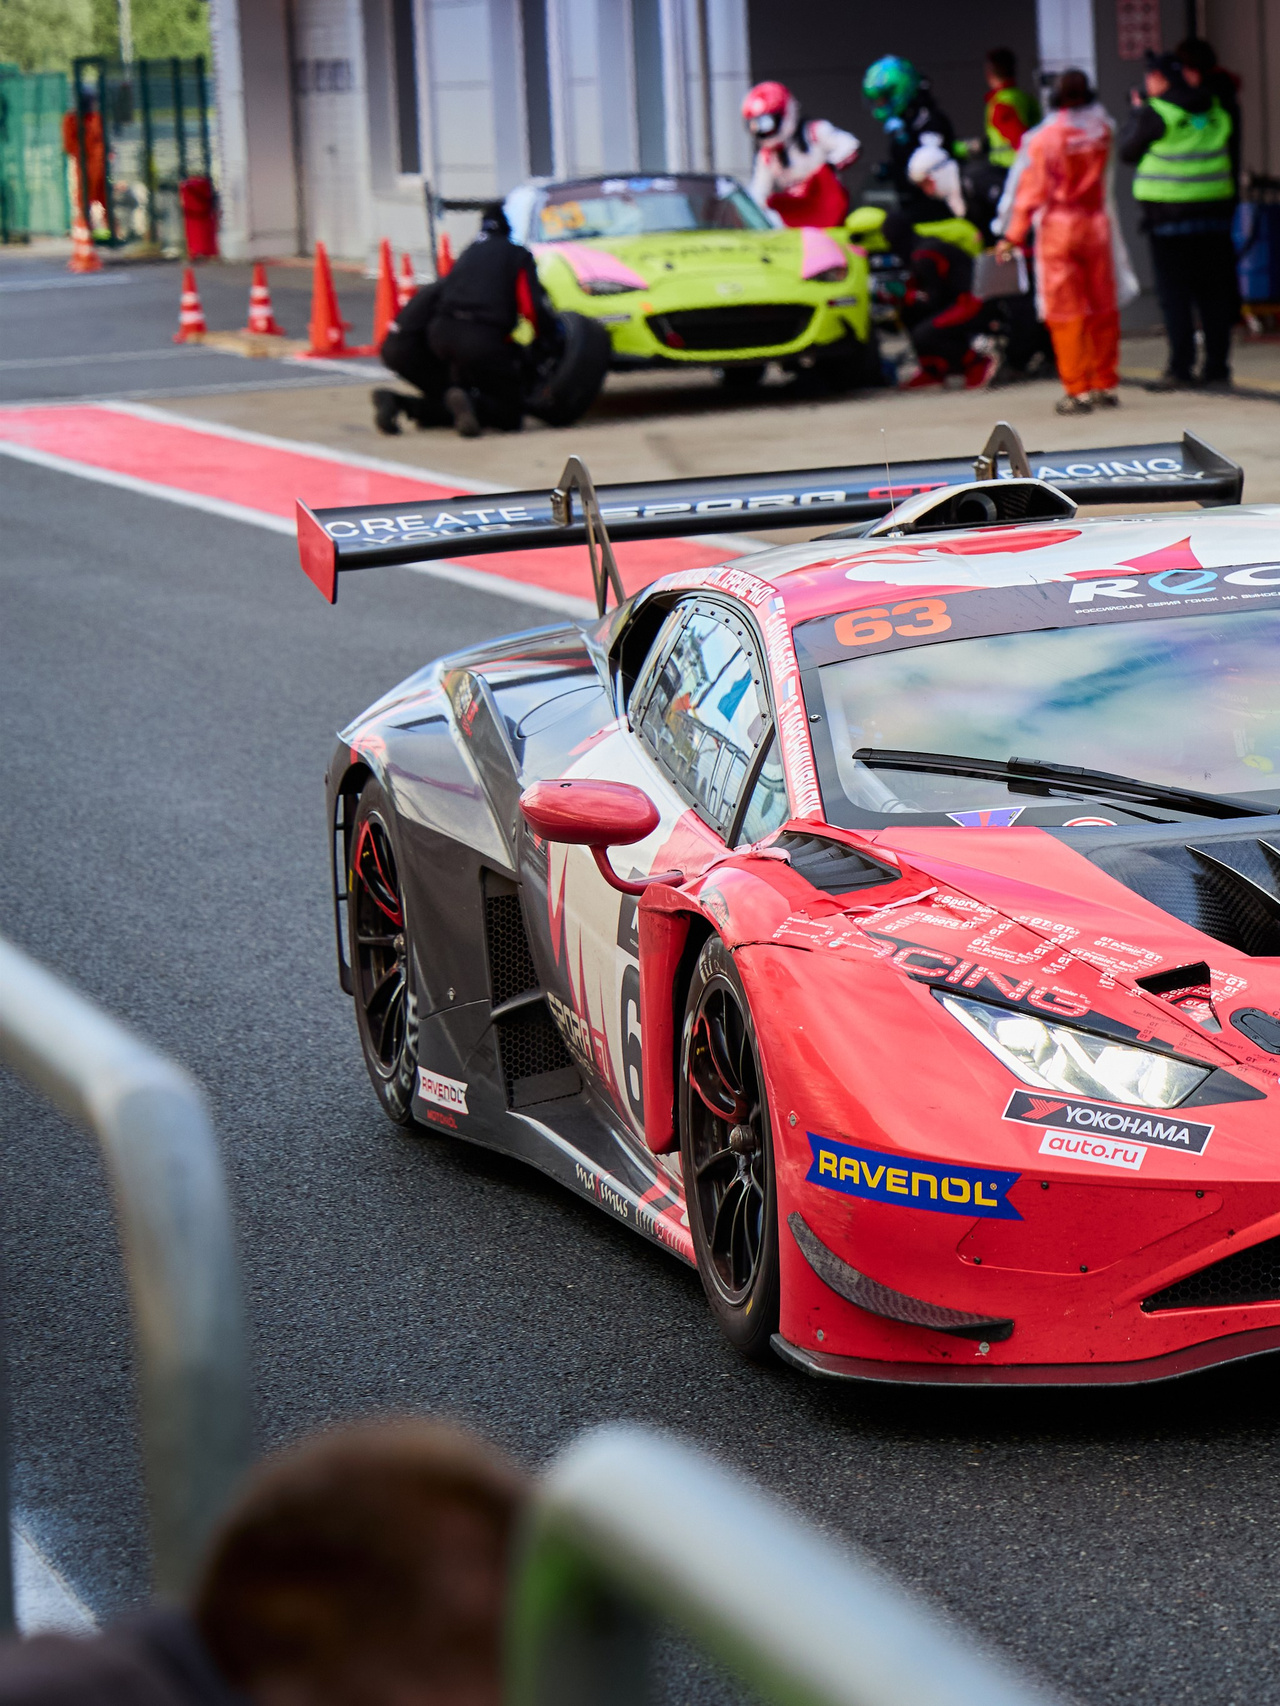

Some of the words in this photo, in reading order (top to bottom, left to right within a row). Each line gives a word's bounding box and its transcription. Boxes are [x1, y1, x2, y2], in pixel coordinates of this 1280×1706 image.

[324, 506, 533, 537] CREATE
[600, 490, 847, 518] SPORA
[1075, 603, 1144, 614] РОССИЙСКАЯ
[1147, 600, 1181, 608] СЕРИЯ
[1184, 596, 1219, 604] ГОНОК
[834, 599, 952, 647] 63
[941, 895, 978, 908] Spora
[922, 914, 958, 926] Spora
[972, 938, 990, 946] GT
[547, 991, 593, 1062] SPORA
[421, 1075, 464, 1104] RAVENOL
[1065, 1104, 1191, 1146] YOKOHAMA
[1047, 1134, 1140, 1164] auto.ru
[817, 1148, 998, 1208] RAVENOL
